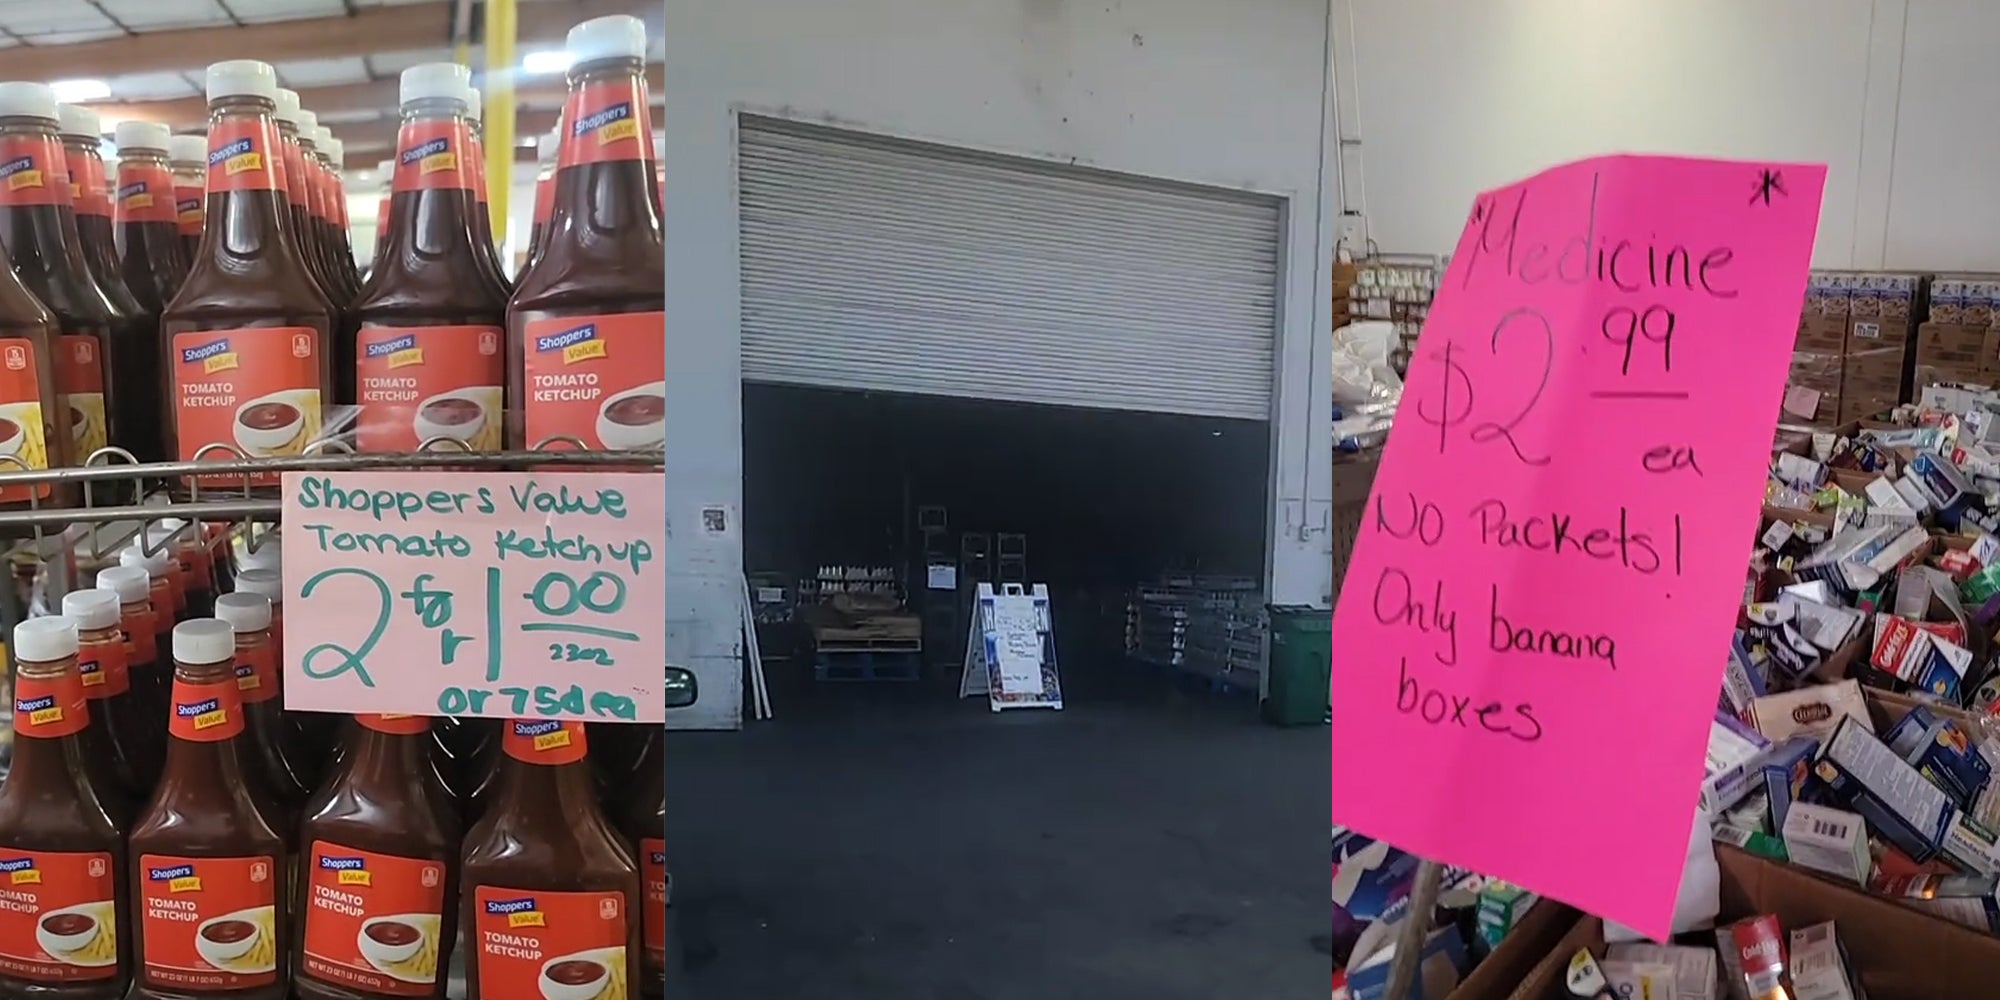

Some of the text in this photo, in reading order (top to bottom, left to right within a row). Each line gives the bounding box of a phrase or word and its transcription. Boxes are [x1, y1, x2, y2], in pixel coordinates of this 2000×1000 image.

[575, 105, 627, 135] Shoppers
[604, 122, 634, 140] Value
[209, 139, 249, 164] Shoppers
[403, 140, 446, 163] Shoppers
[229, 155, 257, 171] Value
[1463, 171, 1739, 298] Medicine
[539, 326, 592, 350] Shoppers
[185, 340, 227, 361] Shoppers
[368, 336, 413, 356] Shoppers
[568, 344, 600, 359] Value
[363, 377, 417, 388] TOMATO
[534, 373, 598, 387] TOMATO
[182, 382, 234, 395] TOMATO
[363, 389, 419, 401] KETCHUP
[534, 388, 601, 402] KETCHUP
[183, 395, 236, 408] KETCHUP
[1643, 445, 1703, 476] ea
[298, 475, 628, 522] Shoppers Value
[303, 523, 472, 558] Tomato
[1373, 566, 1617, 671] Only banana
[300, 566, 394, 688] 2
[17, 697, 51, 712] Shoppers
[437, 685, 494, 715] or
[1396, 655, 1543, 742] boxes
[33, 708, 59, 723] Value
[178, 700, 216, 716] Shoppers
[197, 712, 223, 727] Value
[515, 720, 559, 735] Shoppers
[539, 733, 567, 748] Value
[0, 859, 31, 872] hoppers
[322, 857, 361, 869] Shoppers
[152, 866, 190, 880] Shoppers
[342, 871, 367, 882] Value
[174, 879, 197, 890] Value
[0, 889, 37, 903] OMATO
[315, 885, 364, 906] TOMATO
[0, 902, 39, 915] ETCHUP
[148, 897, 197, 911] TOMATO
[314, 896, 364, 918] KETCHUP
[488, 900, 533, 913] Shoppers
[149, 909, 199, 922] KETCHUP
[513, 913, 540, 925] Value
[484, 931, 539, 948] TOMATO
[485, 943, 542, 960] KETCHUP
